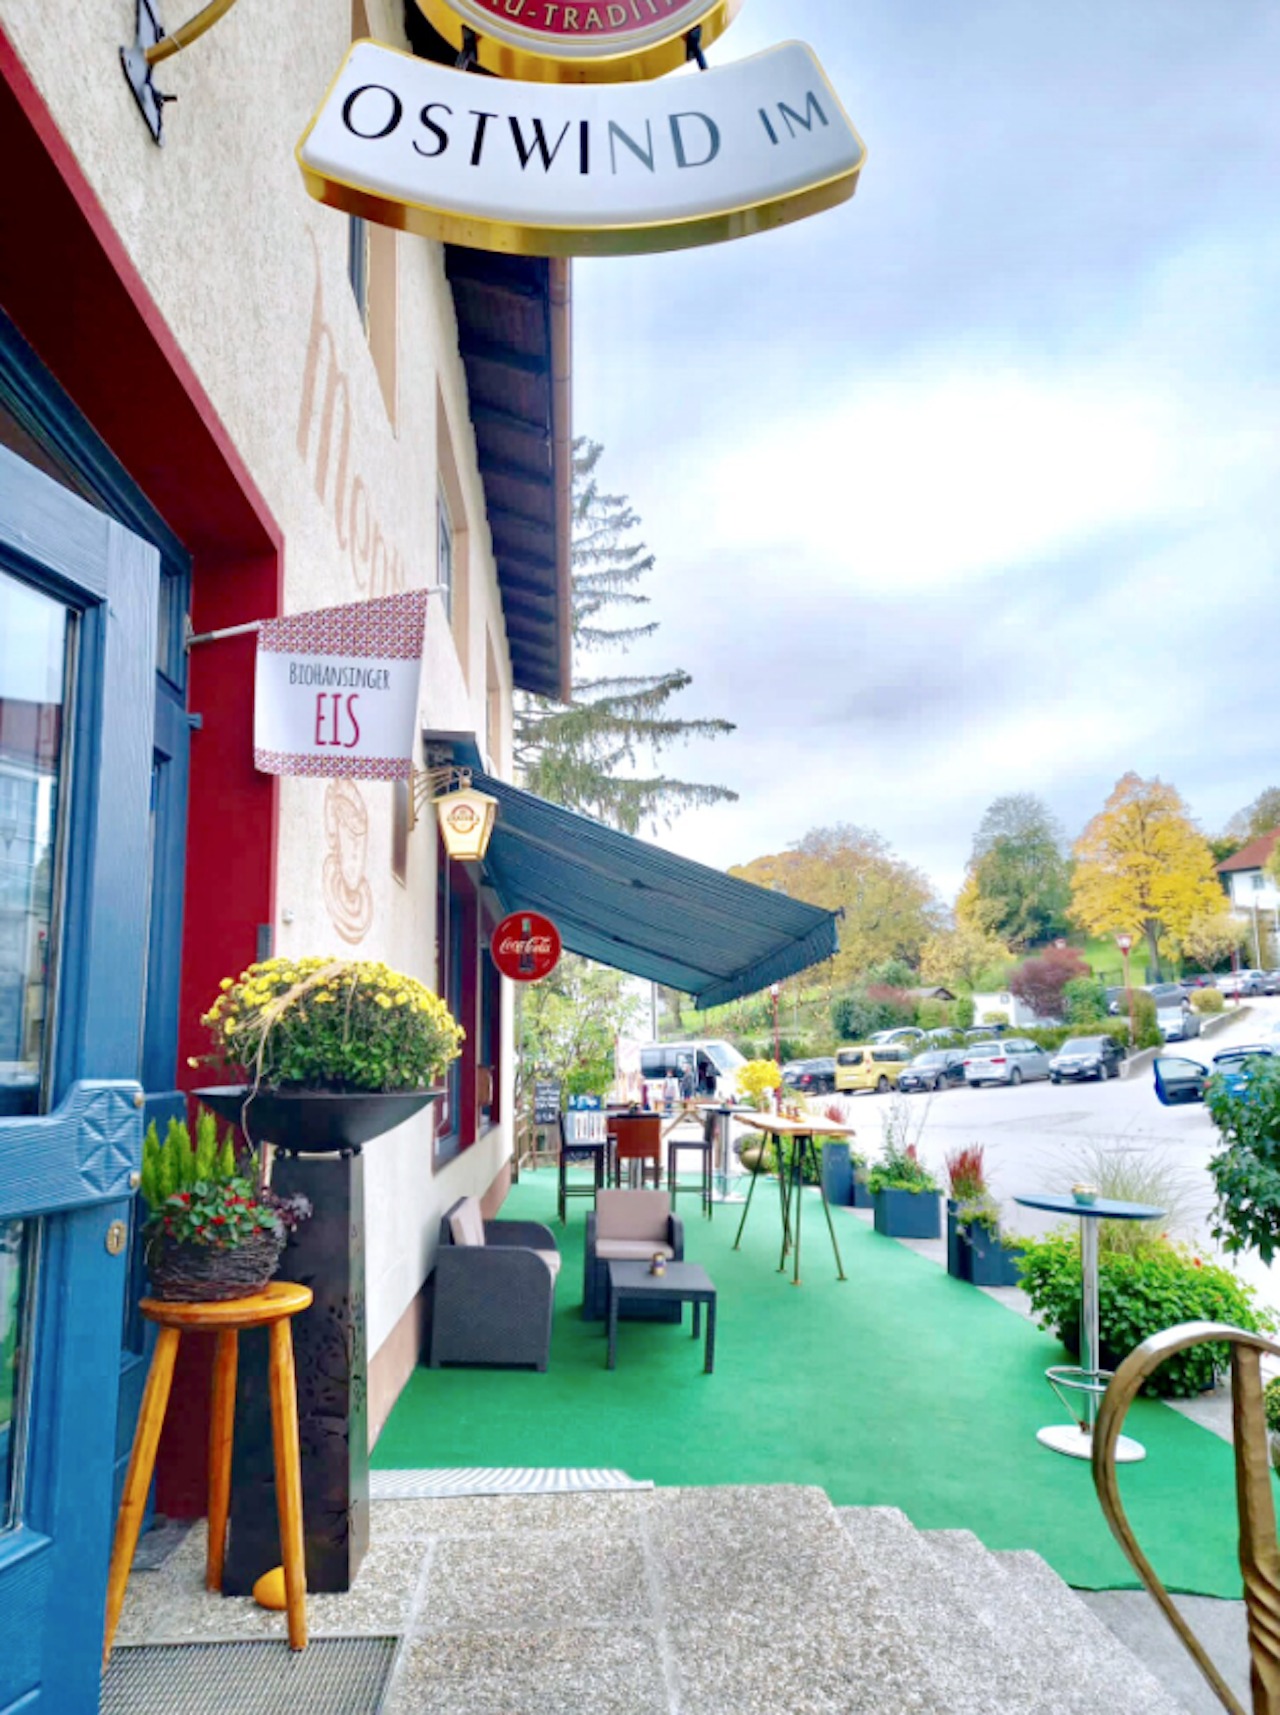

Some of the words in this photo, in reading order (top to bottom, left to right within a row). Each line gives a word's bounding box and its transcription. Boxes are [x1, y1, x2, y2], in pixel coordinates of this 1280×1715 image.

[341, 84, 721, 175] OSTWIND
[758, 90, 829, 146] IM
[289, 661, 390, 690] BIOHANSINGER
[315, 692, 360, 748] EIS
